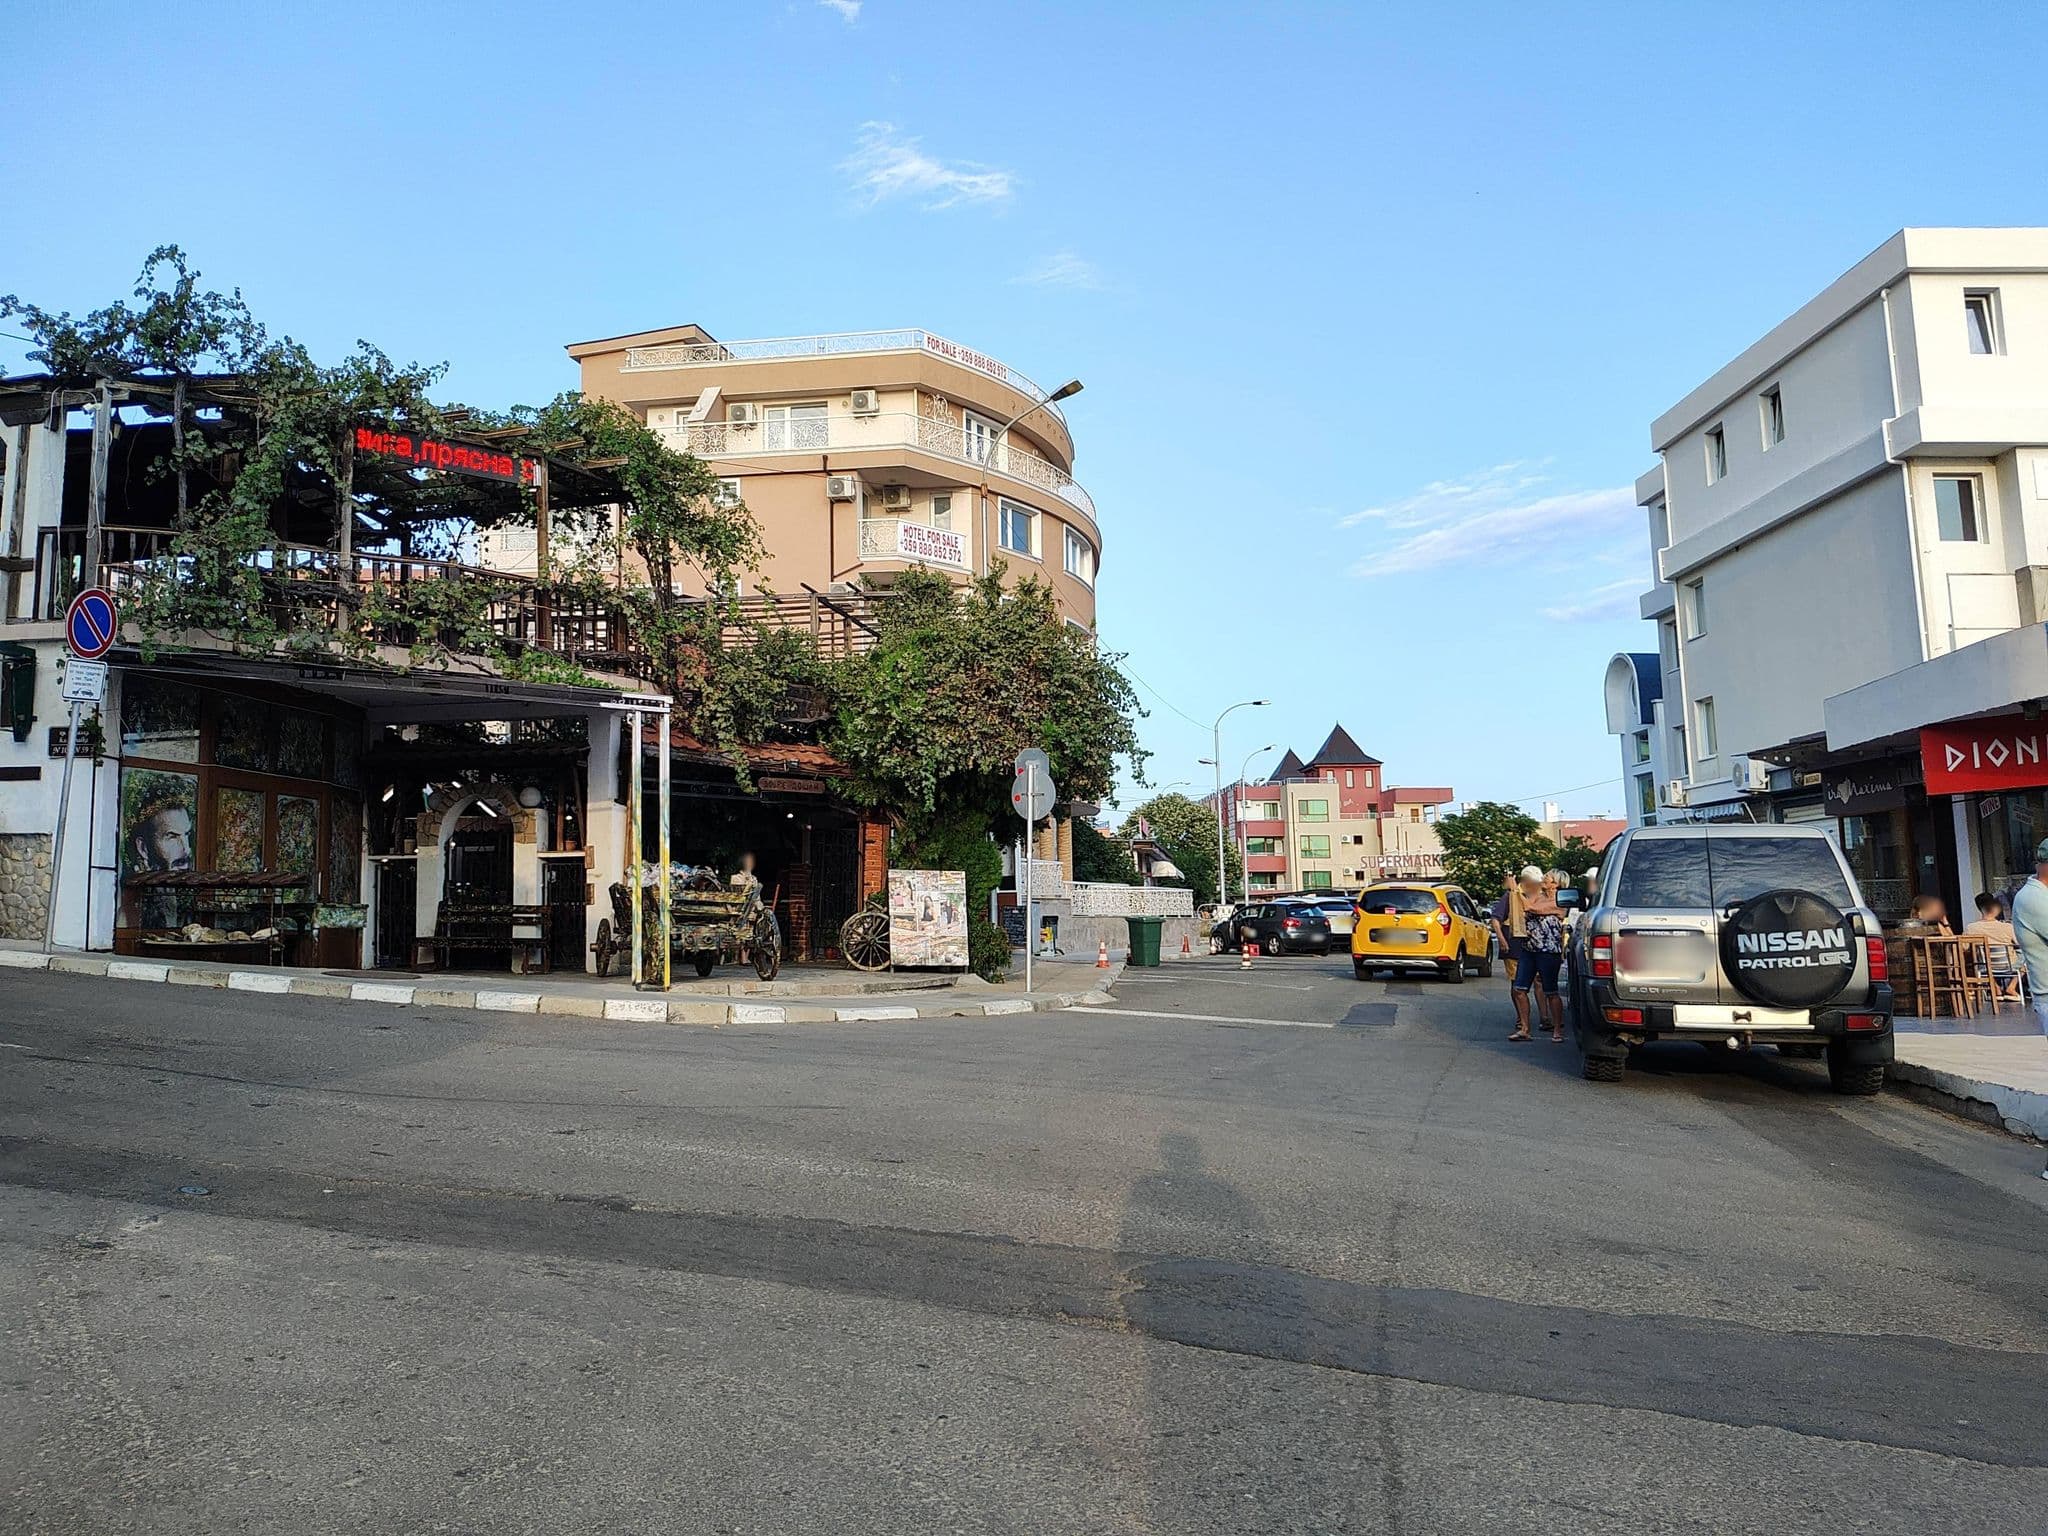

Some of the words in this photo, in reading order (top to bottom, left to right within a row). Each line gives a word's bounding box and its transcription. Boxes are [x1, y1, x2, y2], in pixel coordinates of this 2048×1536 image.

[927, 336, 940, 352] FOR
[941, 342, 957, 358] SALE
[903, 525, 925, 541] HOTEL
[927, 530, 941, 545] FOR
[942, 534, 959, 549] SALE
[900, 538, 917, 553] +359
[919, 542, 933, 556] 888
[934, 545, 947, 560] 852
[949, 549, 962, 562] 572
[1945, 733, 2048, 772] DION
[1361, 854, 1446, 868] SUPERMARK
[1737, 928, 1845, 953] NISSAN
[1739, 956, 1819, 969] PATROL
